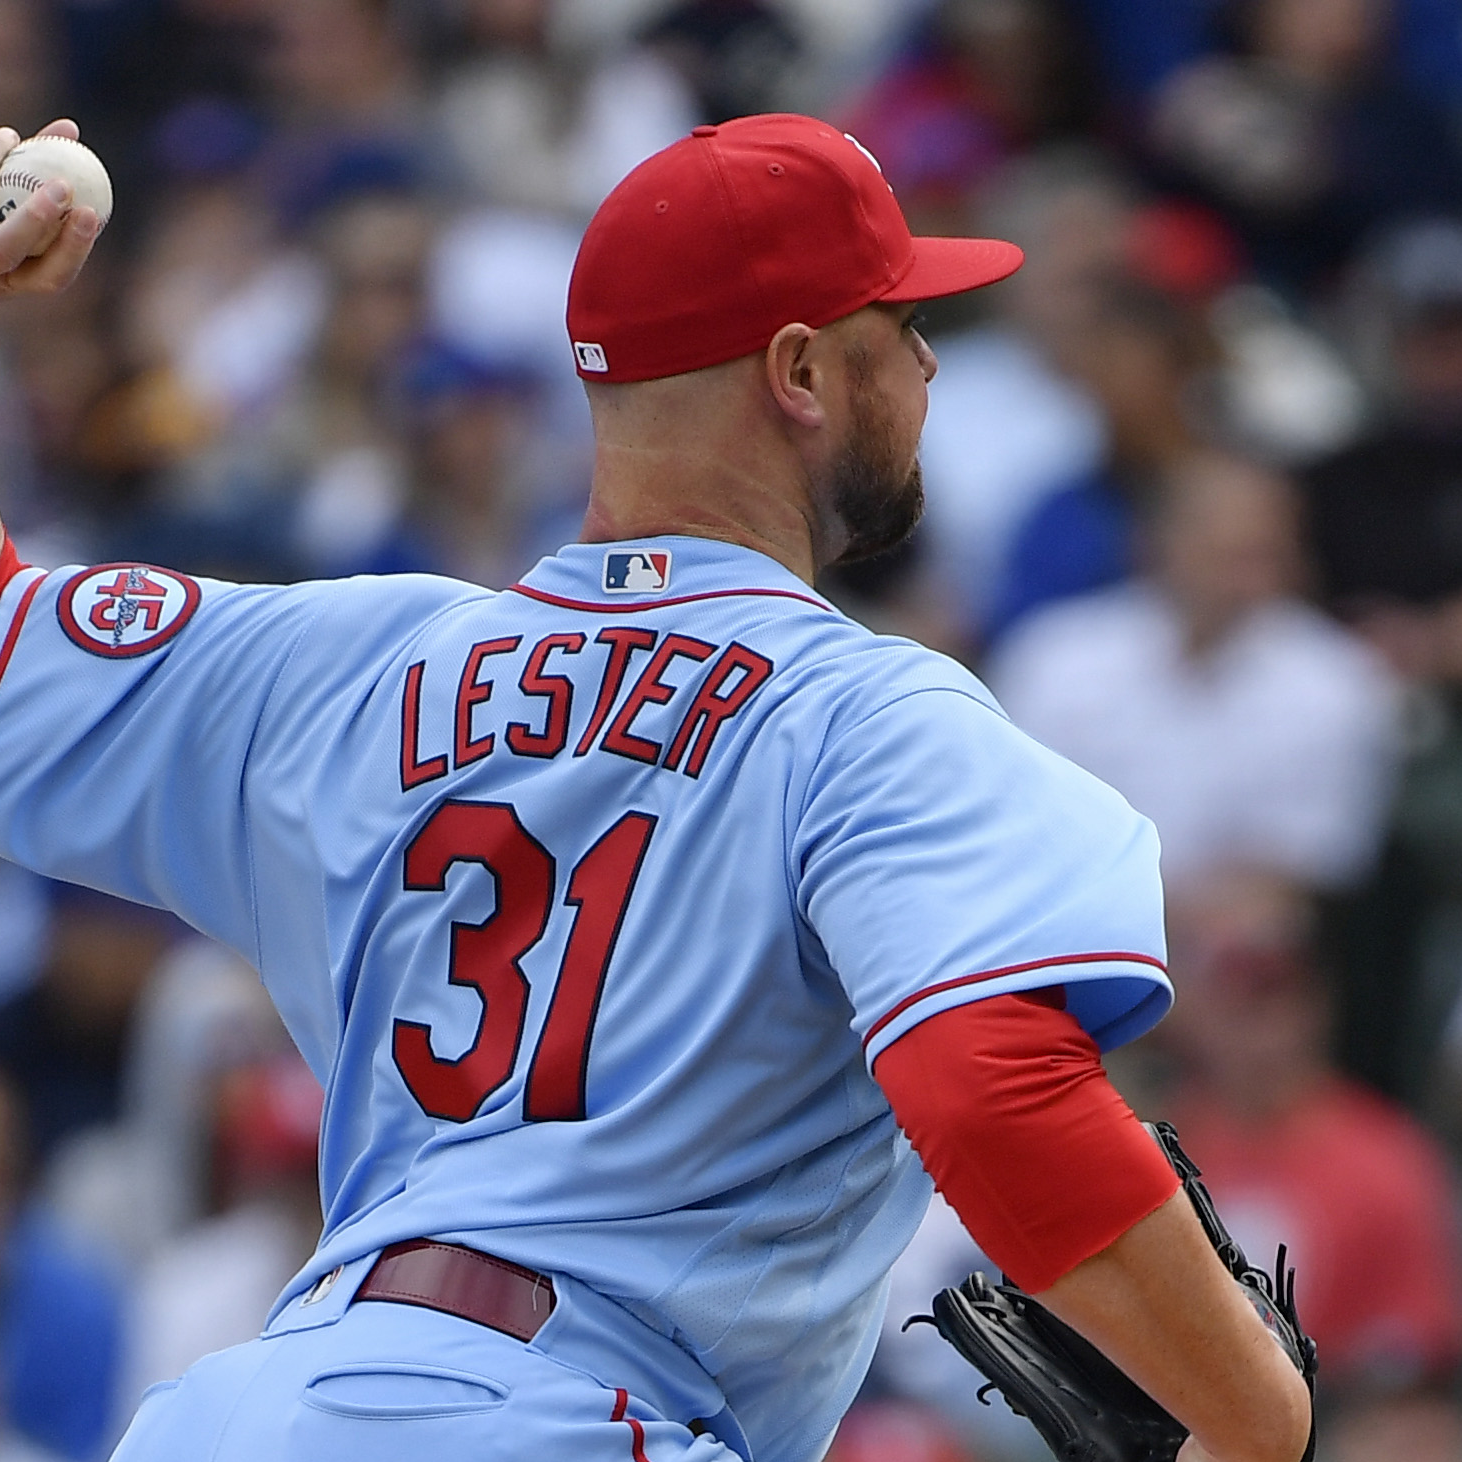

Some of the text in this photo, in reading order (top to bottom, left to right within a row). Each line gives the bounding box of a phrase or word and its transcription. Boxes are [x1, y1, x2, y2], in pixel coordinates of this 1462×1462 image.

[88, 571, 168, 631] 45
[399, 626, 774, 793] LESTER
[391, 798, 659, 1124] 31
